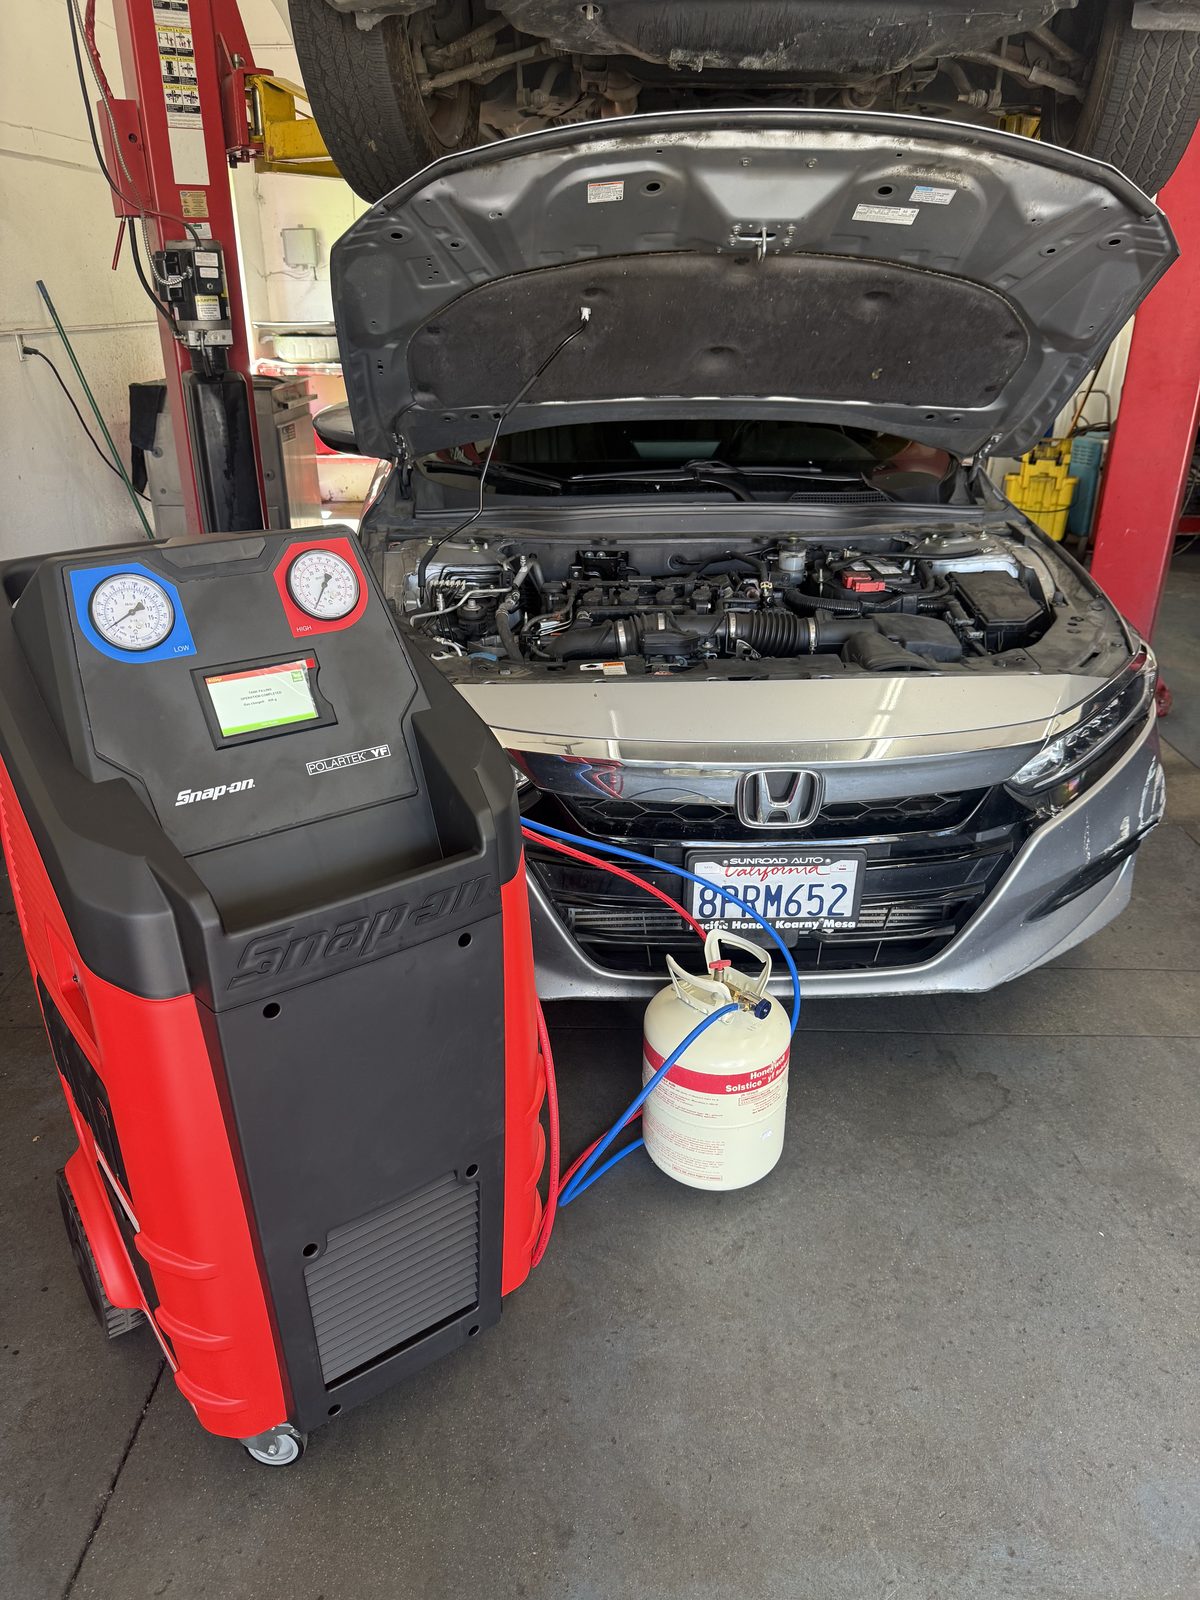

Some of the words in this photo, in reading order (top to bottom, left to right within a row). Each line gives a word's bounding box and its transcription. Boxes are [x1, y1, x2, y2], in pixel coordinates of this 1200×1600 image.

[173, 645, 190, 653] LOW
[308, 752, 367, 773] POLARTEK
[371, 747, 388, 757] YF
[175, 778, 256, 807] Snap-on
[729, 857, 788, 865] SUNROAD
[791, 856, 824, 864] AUTO
[698, 883, 848, 919] 8PRM652
[731, 920, 772, 930] Hon
[775, 920, 820, 930] Kearny
[822, 919, 856, 929] Mesa
